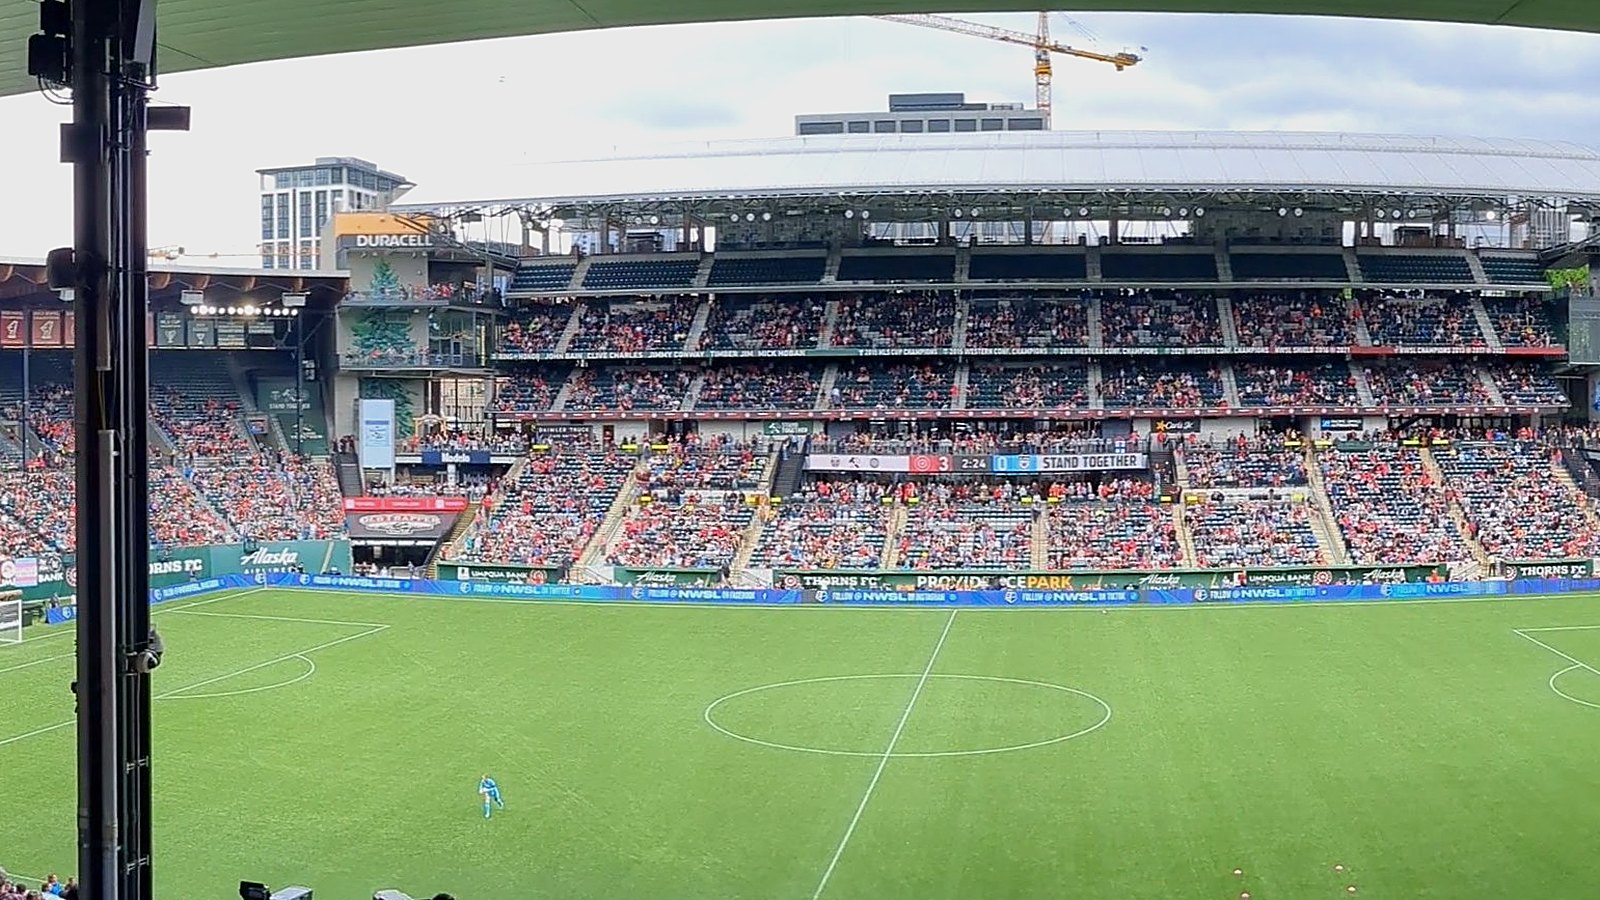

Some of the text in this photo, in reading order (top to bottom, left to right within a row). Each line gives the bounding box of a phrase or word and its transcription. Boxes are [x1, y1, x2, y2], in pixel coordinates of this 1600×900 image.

[356, 234, 434, 248] DURACELL
[938, 457, 949, 470] 3
[962, 459, 986, 469] 2:24
[1043, 455, 1137, 469] STAND TOGETHER
[240, 547, 298, 565] Alaska
[184, 559, 203, 572] FC
[1520, 565, 1587, 577] THORNS FC
[38, 572, 64, 583] BANK
[470, 571, 505, 579] UMPQUA
[636, 572, 677, 583] Alaska
[1139, 574, 1181, 585] Alaska
[1249, 575, 1286, 583] UMPQUA
[803, 576, 878, 586] THORNS FC
[1027, 576, 1073, 588] PARK
